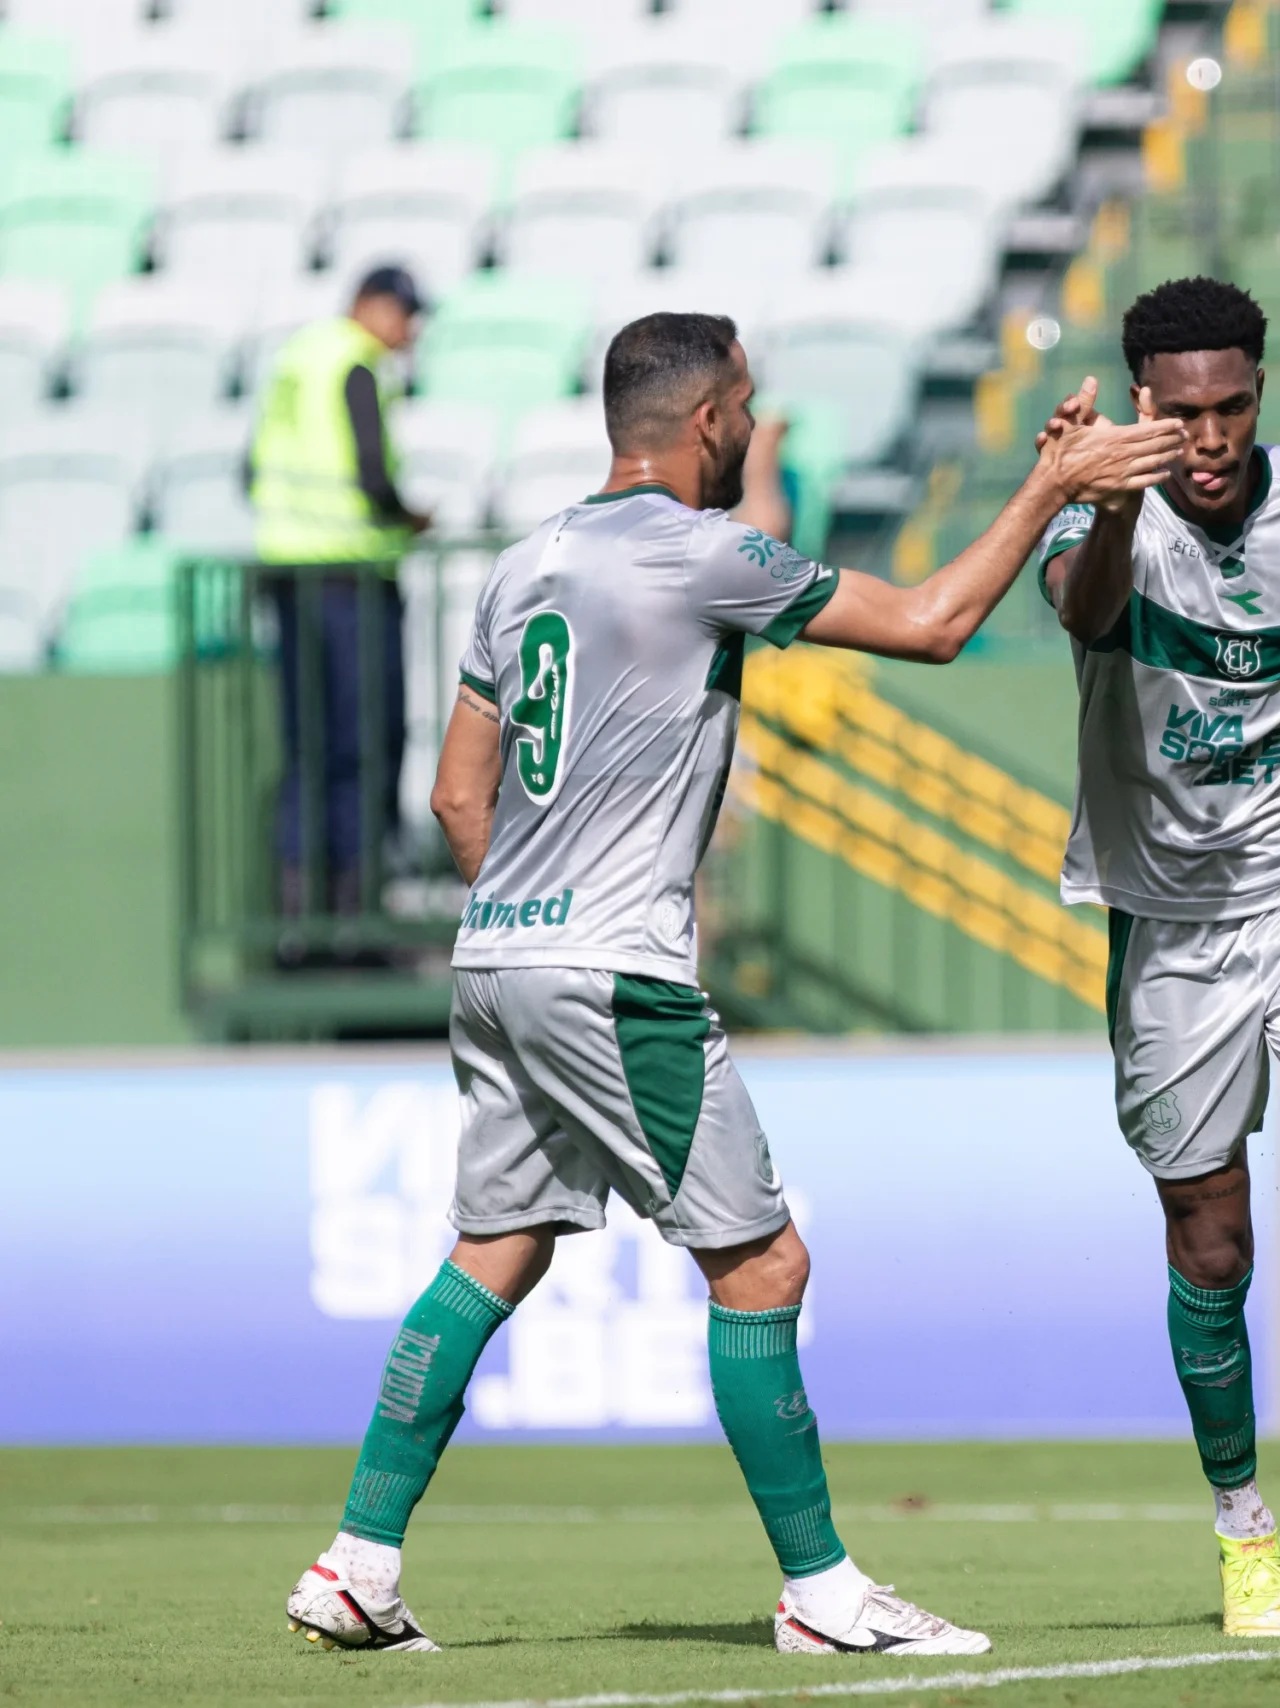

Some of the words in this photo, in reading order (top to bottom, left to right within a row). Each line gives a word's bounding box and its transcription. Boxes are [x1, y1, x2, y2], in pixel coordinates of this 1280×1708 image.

[510, 609, 576, 806] 9
[1166, 703, 1243, 742] VIVA
[1209, 697, 1251, 707] SORTE
[463, 887, 574, 930] nimed
